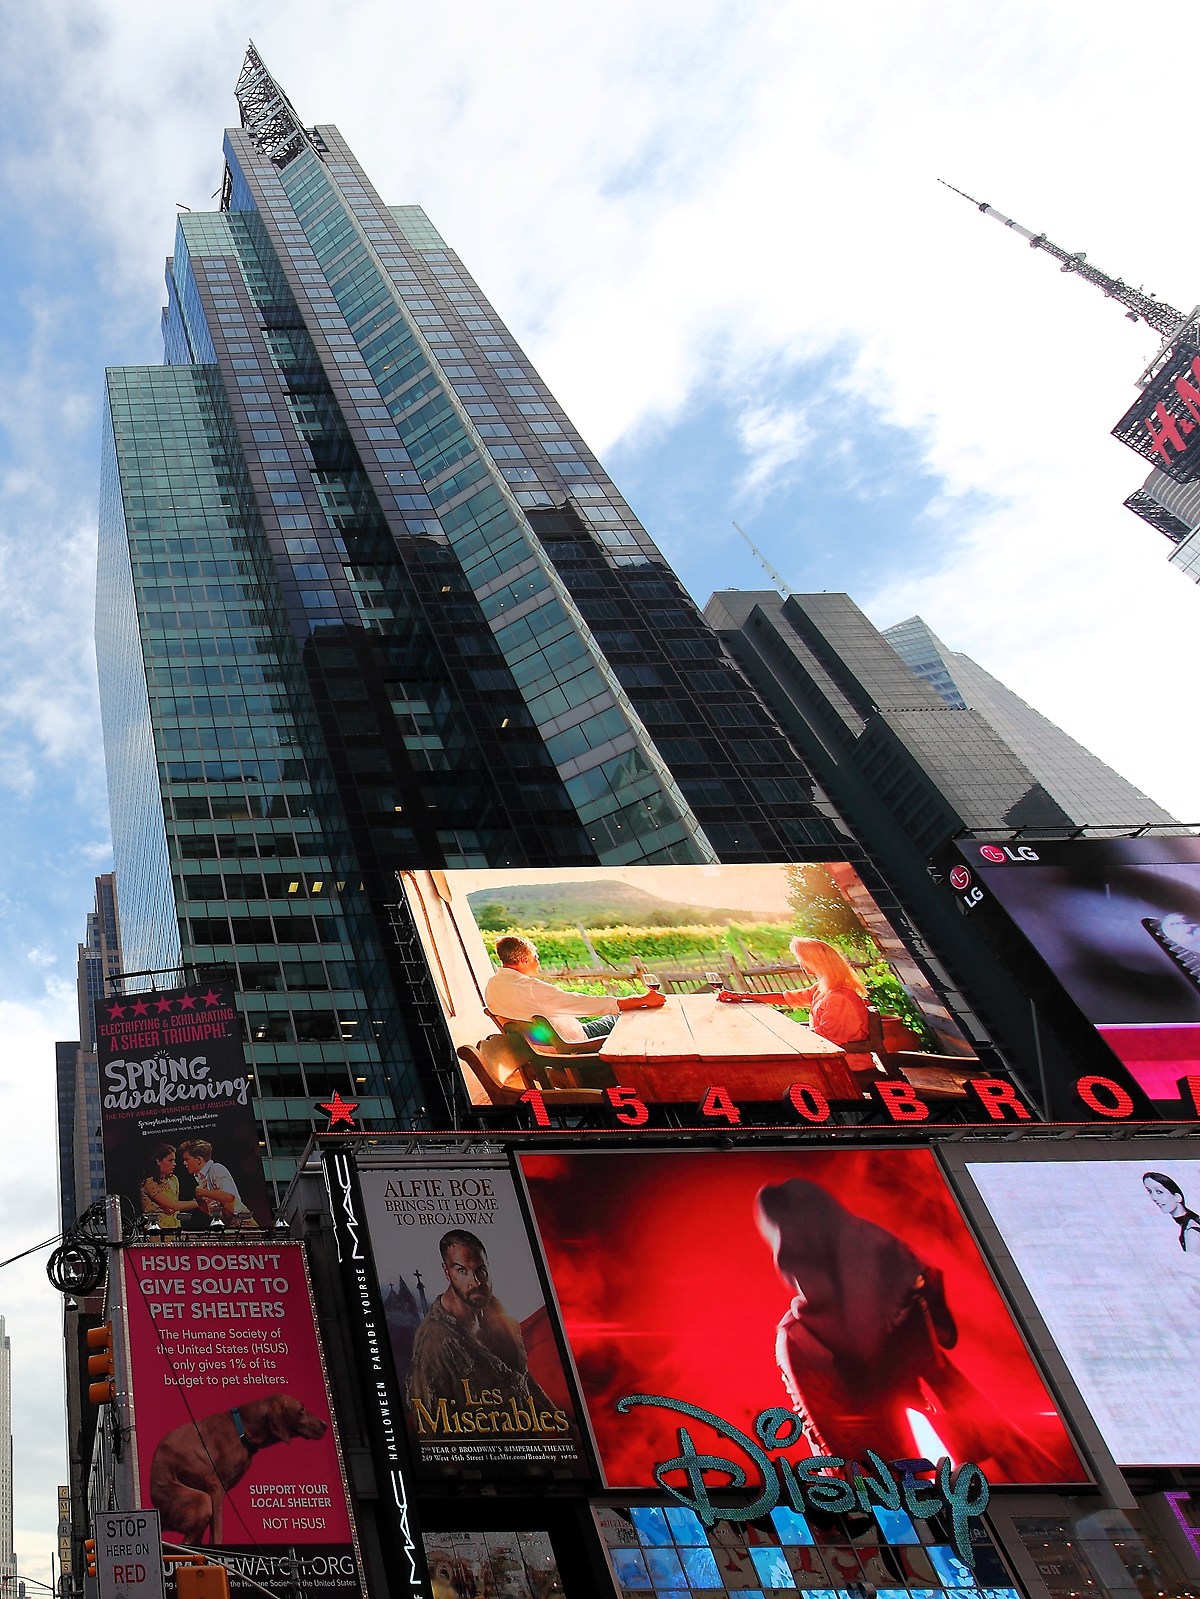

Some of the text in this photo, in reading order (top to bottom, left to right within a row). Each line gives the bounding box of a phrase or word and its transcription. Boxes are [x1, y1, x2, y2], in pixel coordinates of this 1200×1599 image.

[1003, 846, 1040, 861] LG
[963, 886, 984, 908] LG
[162, 1021, 170, 1029] &
[110, 1036, 119, 1052] A
[121, 1031, 160, 1050] SHEER
[104, 1056, 211, 1092] SPRING
[104, 1076, 250, 1110] awakening
[520, 1075, 1200, 1127] 1540 BRO
[191, 1103, 207, 1111] BEST
[207, 1101, 238, 1109] MUSICAL
[383, 1178, 494, 1198] ALFIE BOE
[385, 1198, 498, 1212] BRINGS IT HOME
[393, 1212, 494, 1226] TO BROADWAY
[141, 1254, 281, 1271] HSUS DOESN'T
[139, 1277, 289, 1295] GIVE SQUAT TO
[150, 1302, 285, 1319] PET SHELTERS
[159, 1327, 281, 1341] The Humane Society of
[156, 1343, 289, 1355] the United States (HSUS)
[365, 1322, 382, 1370] PARADE
[173, 1358, 276, 1372] only gives 1% of its
[164, 1373, 289, 1388] budget to pet shelters.
[461, 1378, 504, 1406] Les
[377, 1382, 398, 1460] HALLOWEEN
[411, 1396, 570, 1434] Misérables
[431, 1446, 450, 1454] YEAR
[466, 1453, 484, 1461] Street
[249, 1484, 329, 1495] SUPPORT YOUR
[251, 1497, 332, 1508] LOCAL SHELTER
[106, 1518, 147, 1538] STOP
[262, 1517, 326, 1530] NOT HSUS!
[60, 1502, 69, 1571] MARAIS
[106, 1543, 149, 1556] HERE ON
[113, 1564, 146, 1584] RED
